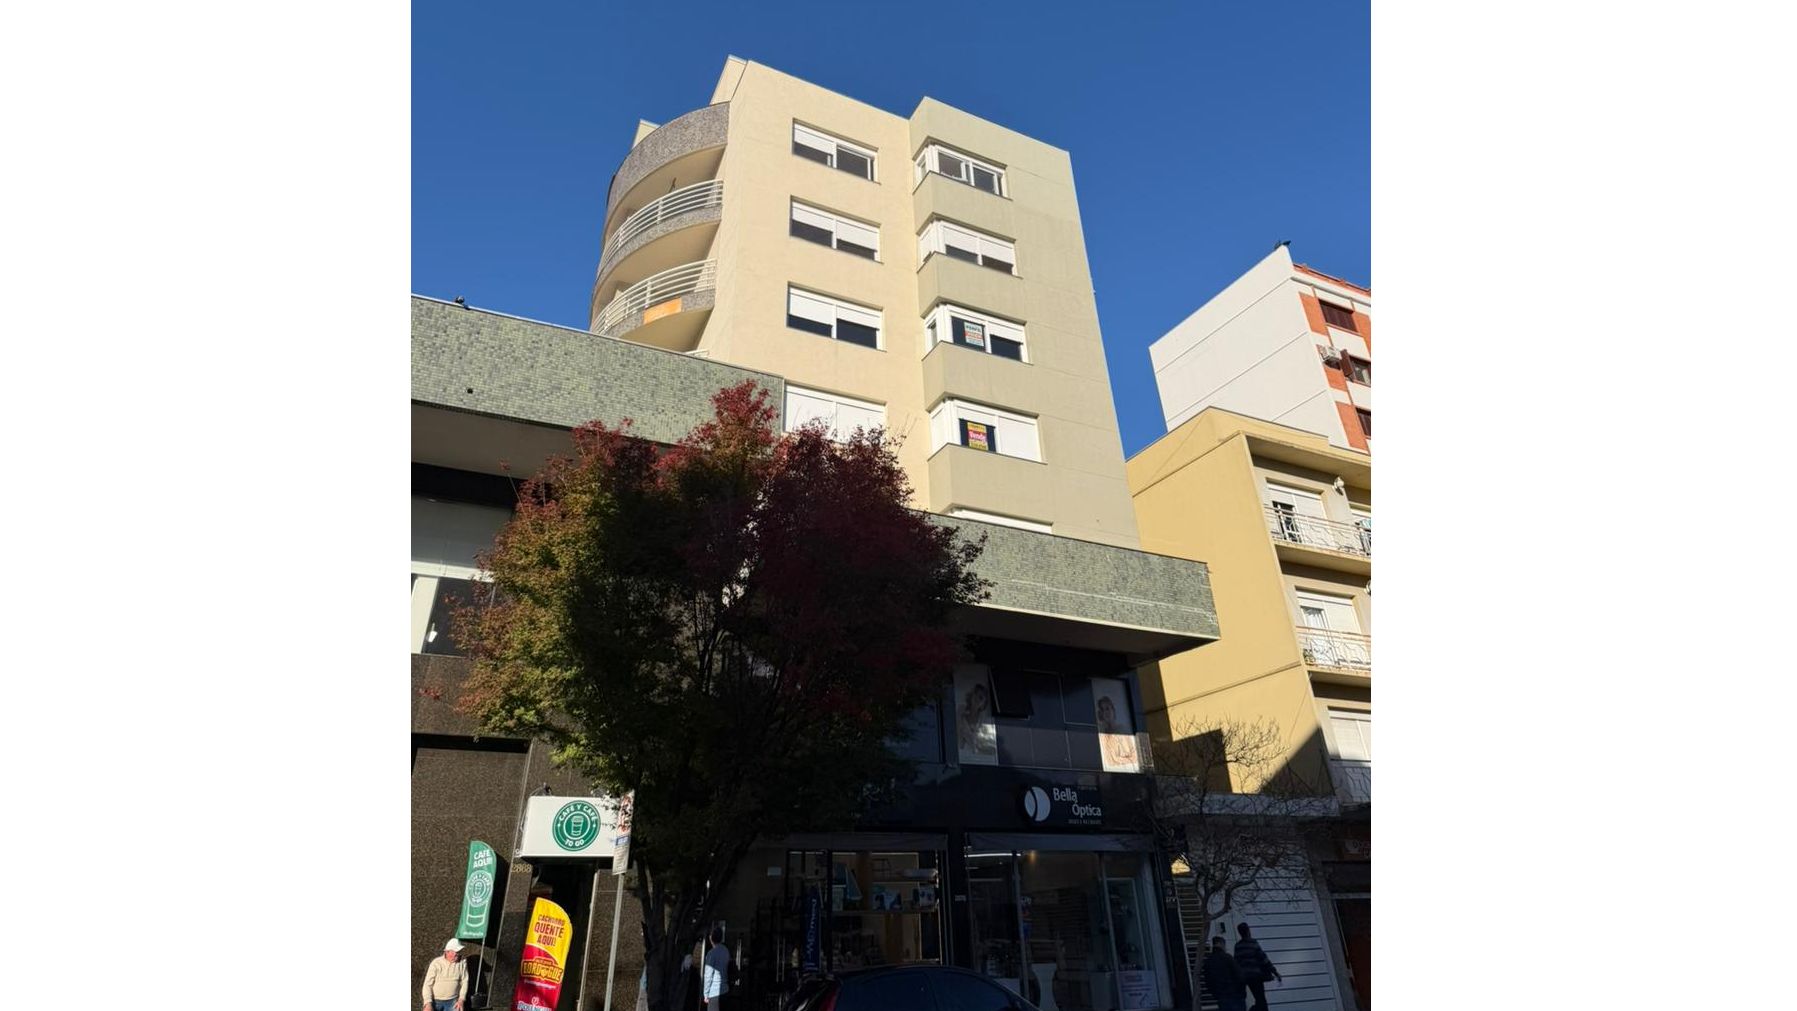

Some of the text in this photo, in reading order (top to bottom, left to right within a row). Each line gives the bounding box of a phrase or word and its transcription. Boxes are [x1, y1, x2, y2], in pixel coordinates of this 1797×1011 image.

[1052, 787, 1078, 802] Bella
[565, 839, 585, 847] TO GO
[534, 921, 565, 938] QUENTE
